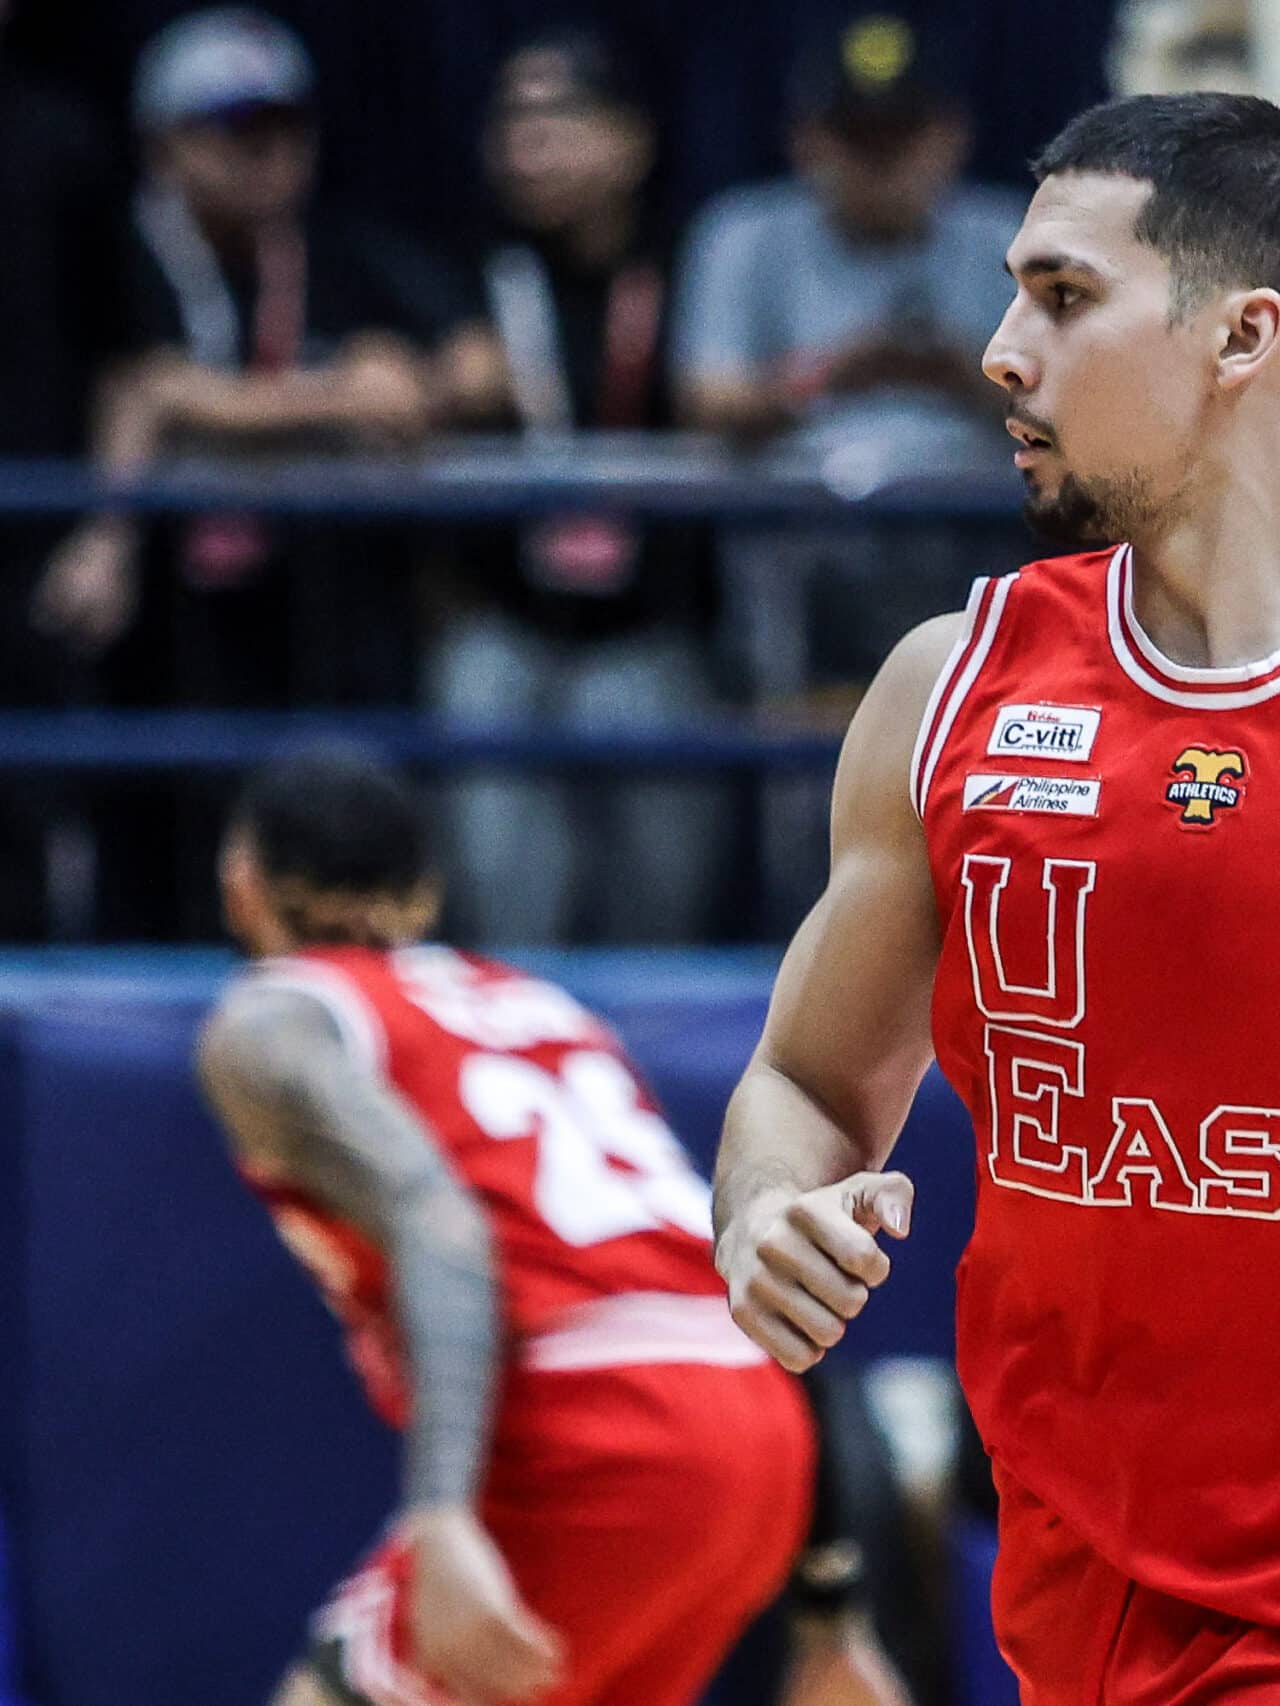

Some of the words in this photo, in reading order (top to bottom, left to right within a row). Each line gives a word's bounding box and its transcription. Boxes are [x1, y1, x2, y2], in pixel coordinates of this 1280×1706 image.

[1003, 723, 1077, 750] C-vitt
[1018, 777, 1090, 797] Philippine
[1168, 782, 1237, 805] ATHLETICS
[1013, 794, 1069, 811] Airlines
[961, 854, 1096, 1029] U
